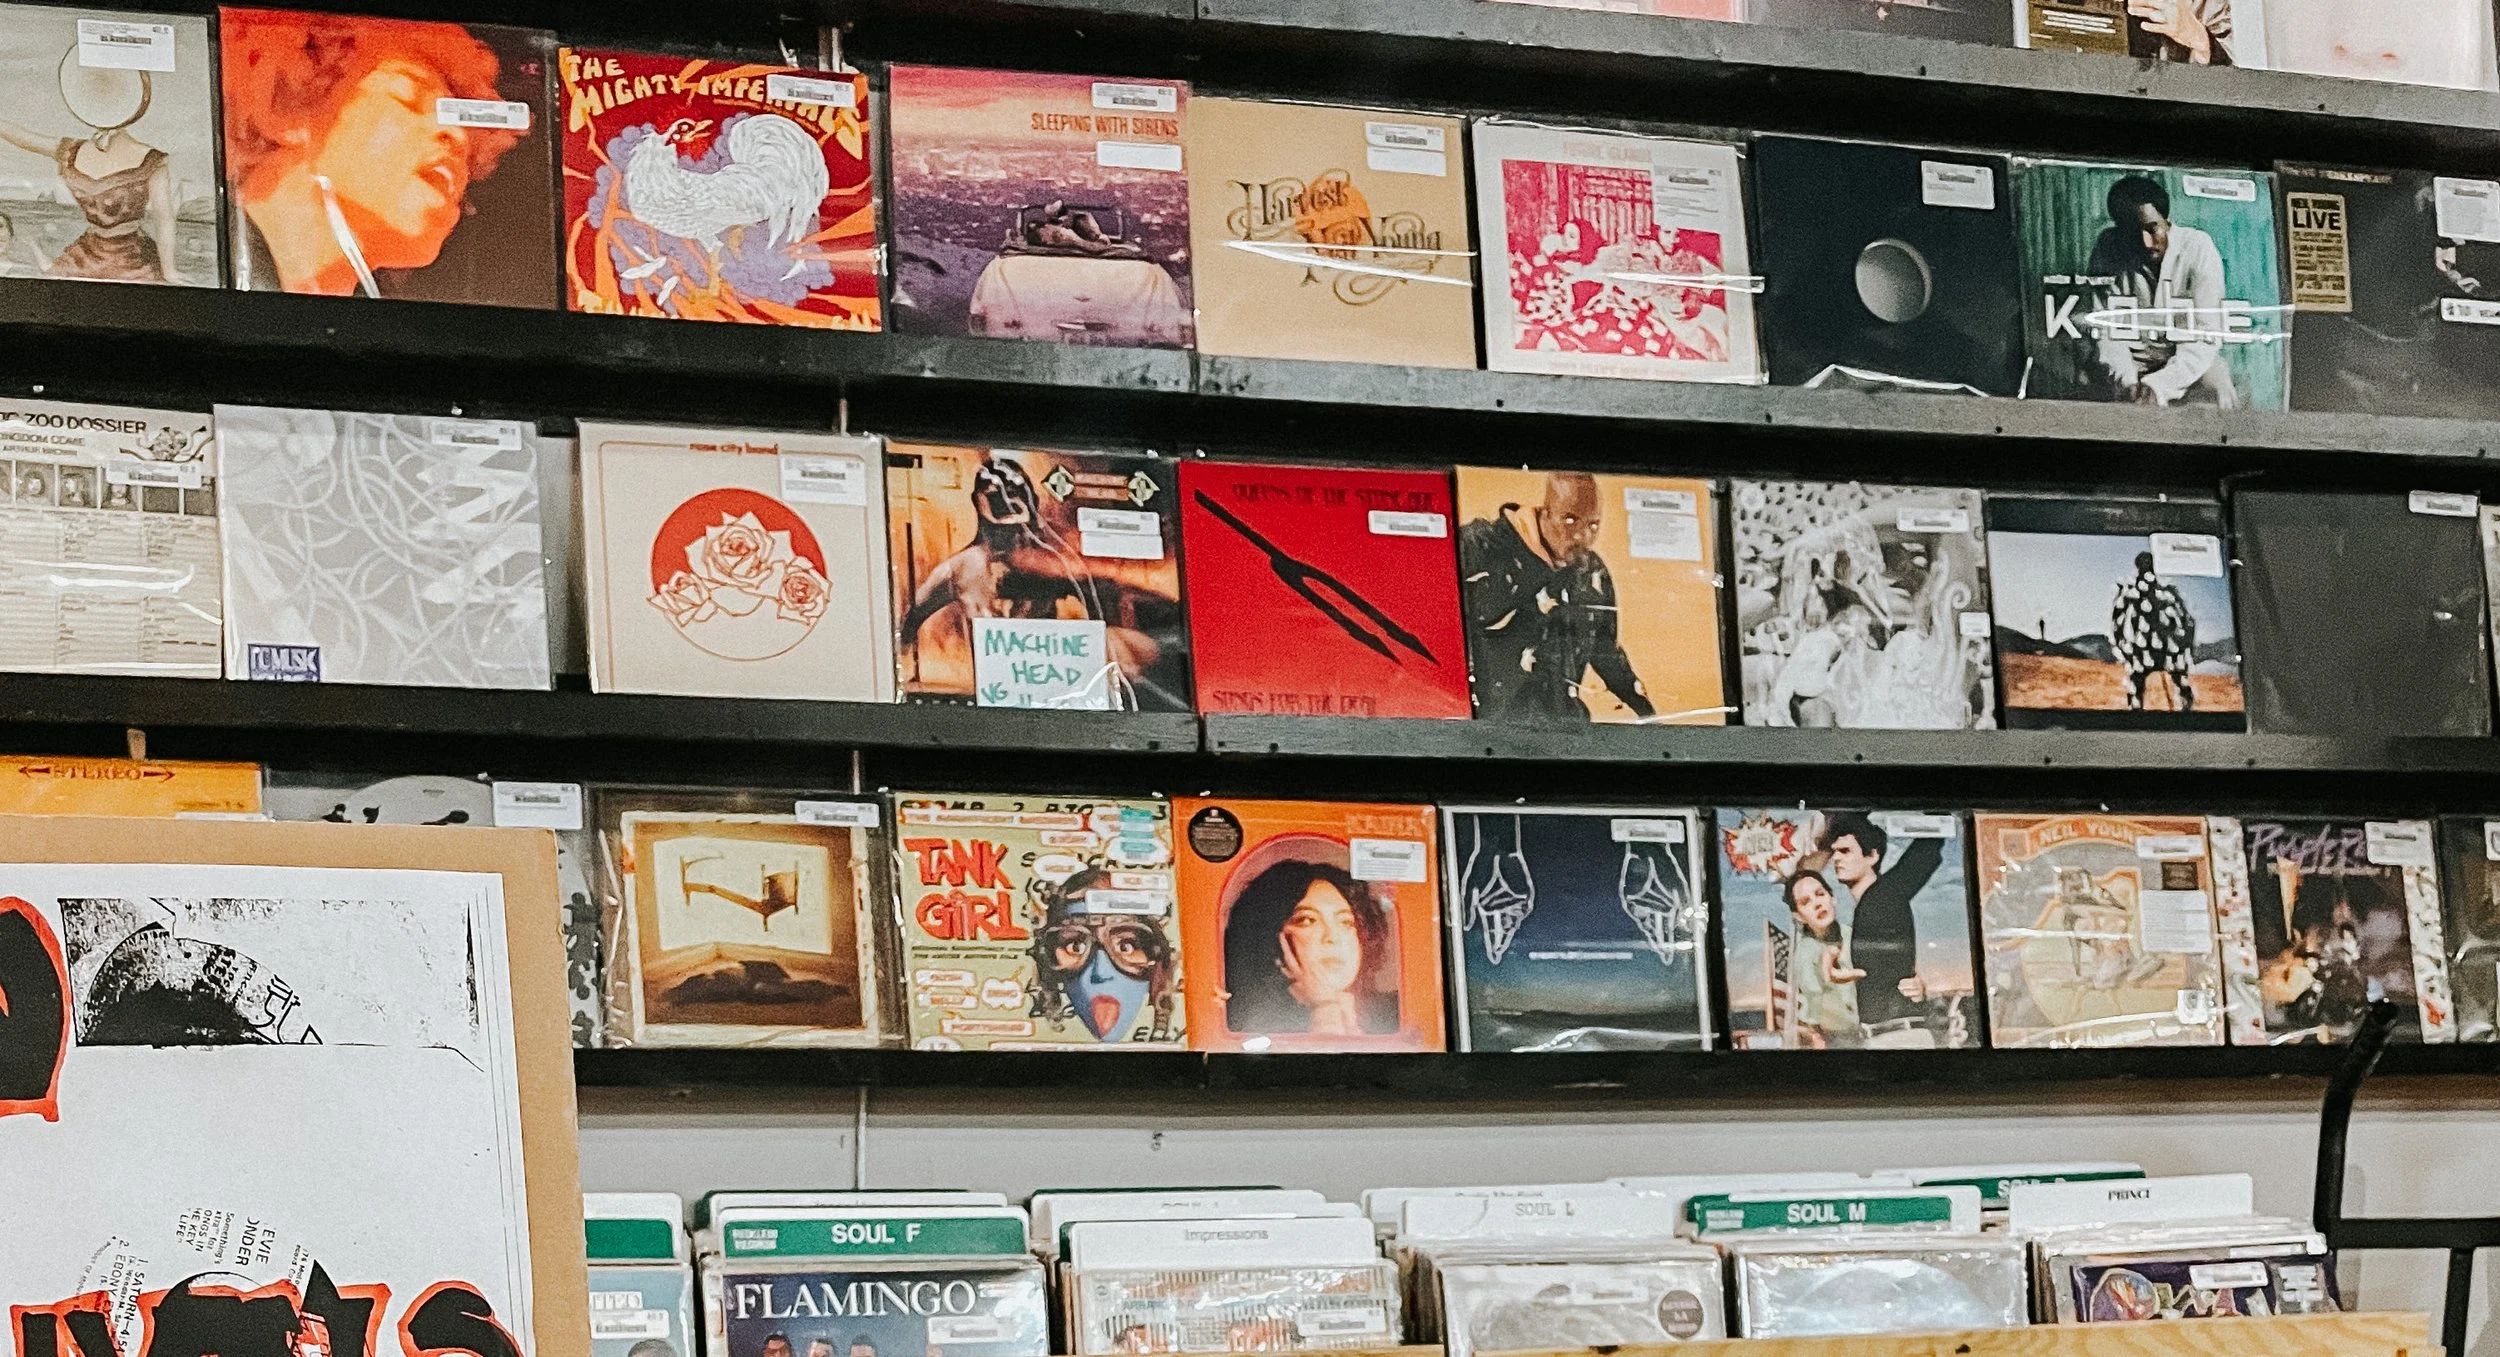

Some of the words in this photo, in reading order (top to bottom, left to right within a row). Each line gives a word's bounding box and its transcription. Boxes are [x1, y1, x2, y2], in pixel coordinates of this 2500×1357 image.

[566, 55, 625, 83] THE
[569, 75, 684, 133] MIGHTY
[1031, 112, 1091, 133] SLEEPING
[1095, 115, 1128, 134] WITH
[1132, 117, 1180, 136] SIRENS
[2292, 211, 2342, 230] LIVE
[24, 412, 64, 429] ZOO
[67, 416, 148, 434] DOSSIER
[1011, 660, 1082, 686] HEAD
[981, 682, 1008, 703] VG
[2088, 822, 2137, 846] YOUN
[903, 838, 1015, 890] TANK
[1514, 1202, 1556, 1217] SOUL
[1786, 1203, 1841, 1224] SOUL
[1848, 1202, 1866, 1222] M
[186, 1224, 197, 1246] KEY
[255, 1226, 276, 1264] EVIE
[830, 1222, 896, 1245] SOUL
[906, 1222, 922, 1244] F
[1184, 1228, 1269, 1242] Impressions
[734, 1280, 977, 1321] FLAMINGO
